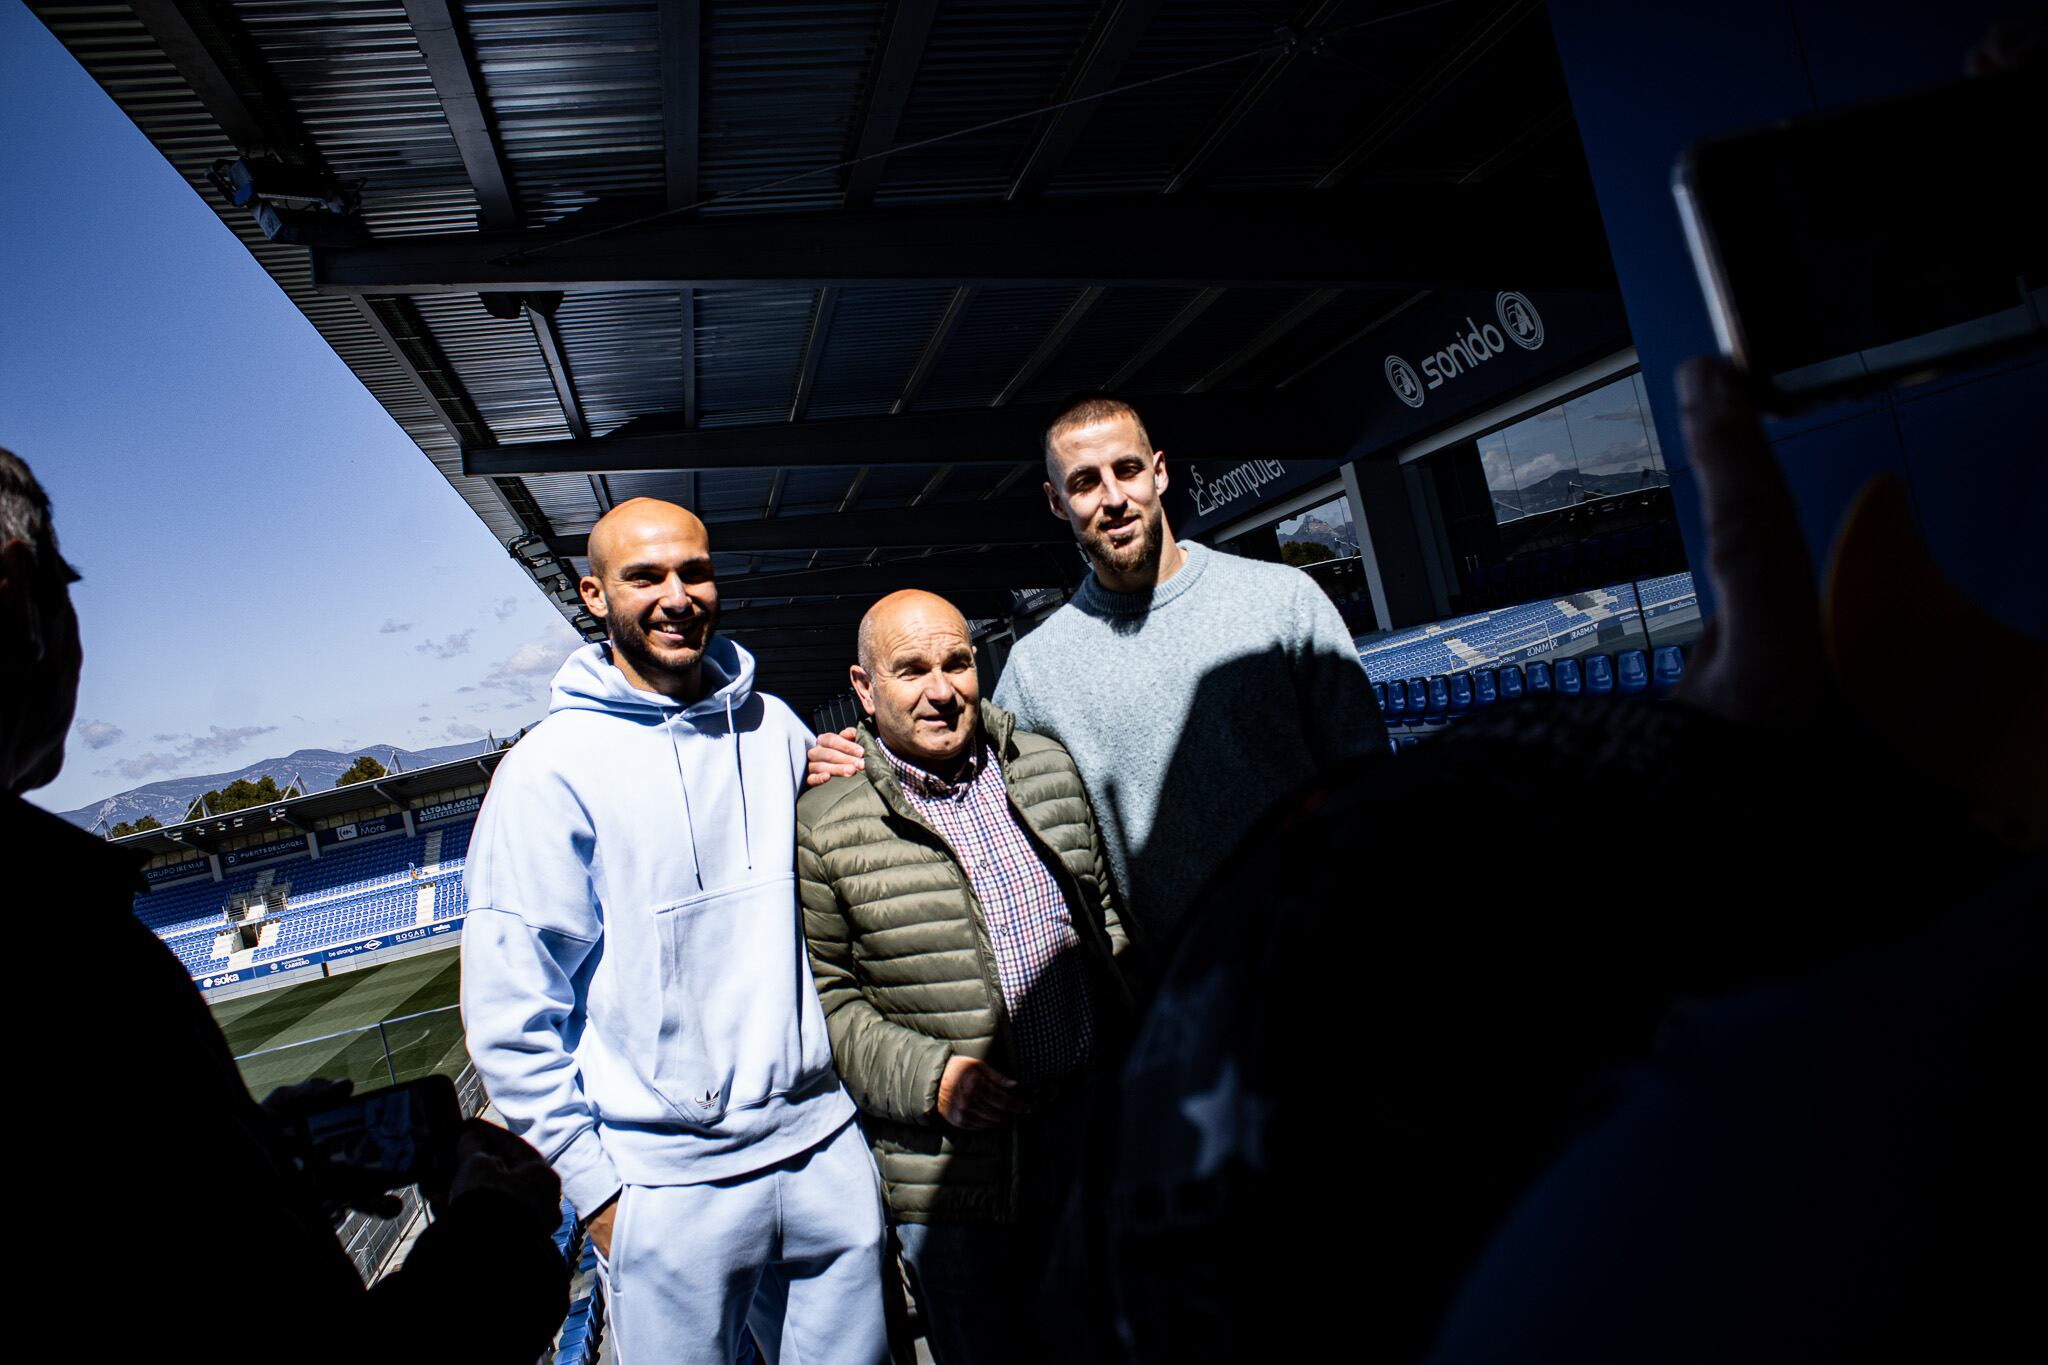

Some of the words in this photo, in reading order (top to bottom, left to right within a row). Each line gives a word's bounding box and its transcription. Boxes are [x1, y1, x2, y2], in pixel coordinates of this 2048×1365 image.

[1421, 316, 1505, 390] sonido
[360, 824, 386, 836] More
[147, 867, 175, 879] GRUPO
[395, 929, 425, 941] ROGAR
[284, 959, 310, 970] CABRERO
[213, 973, 239, 986] soka
